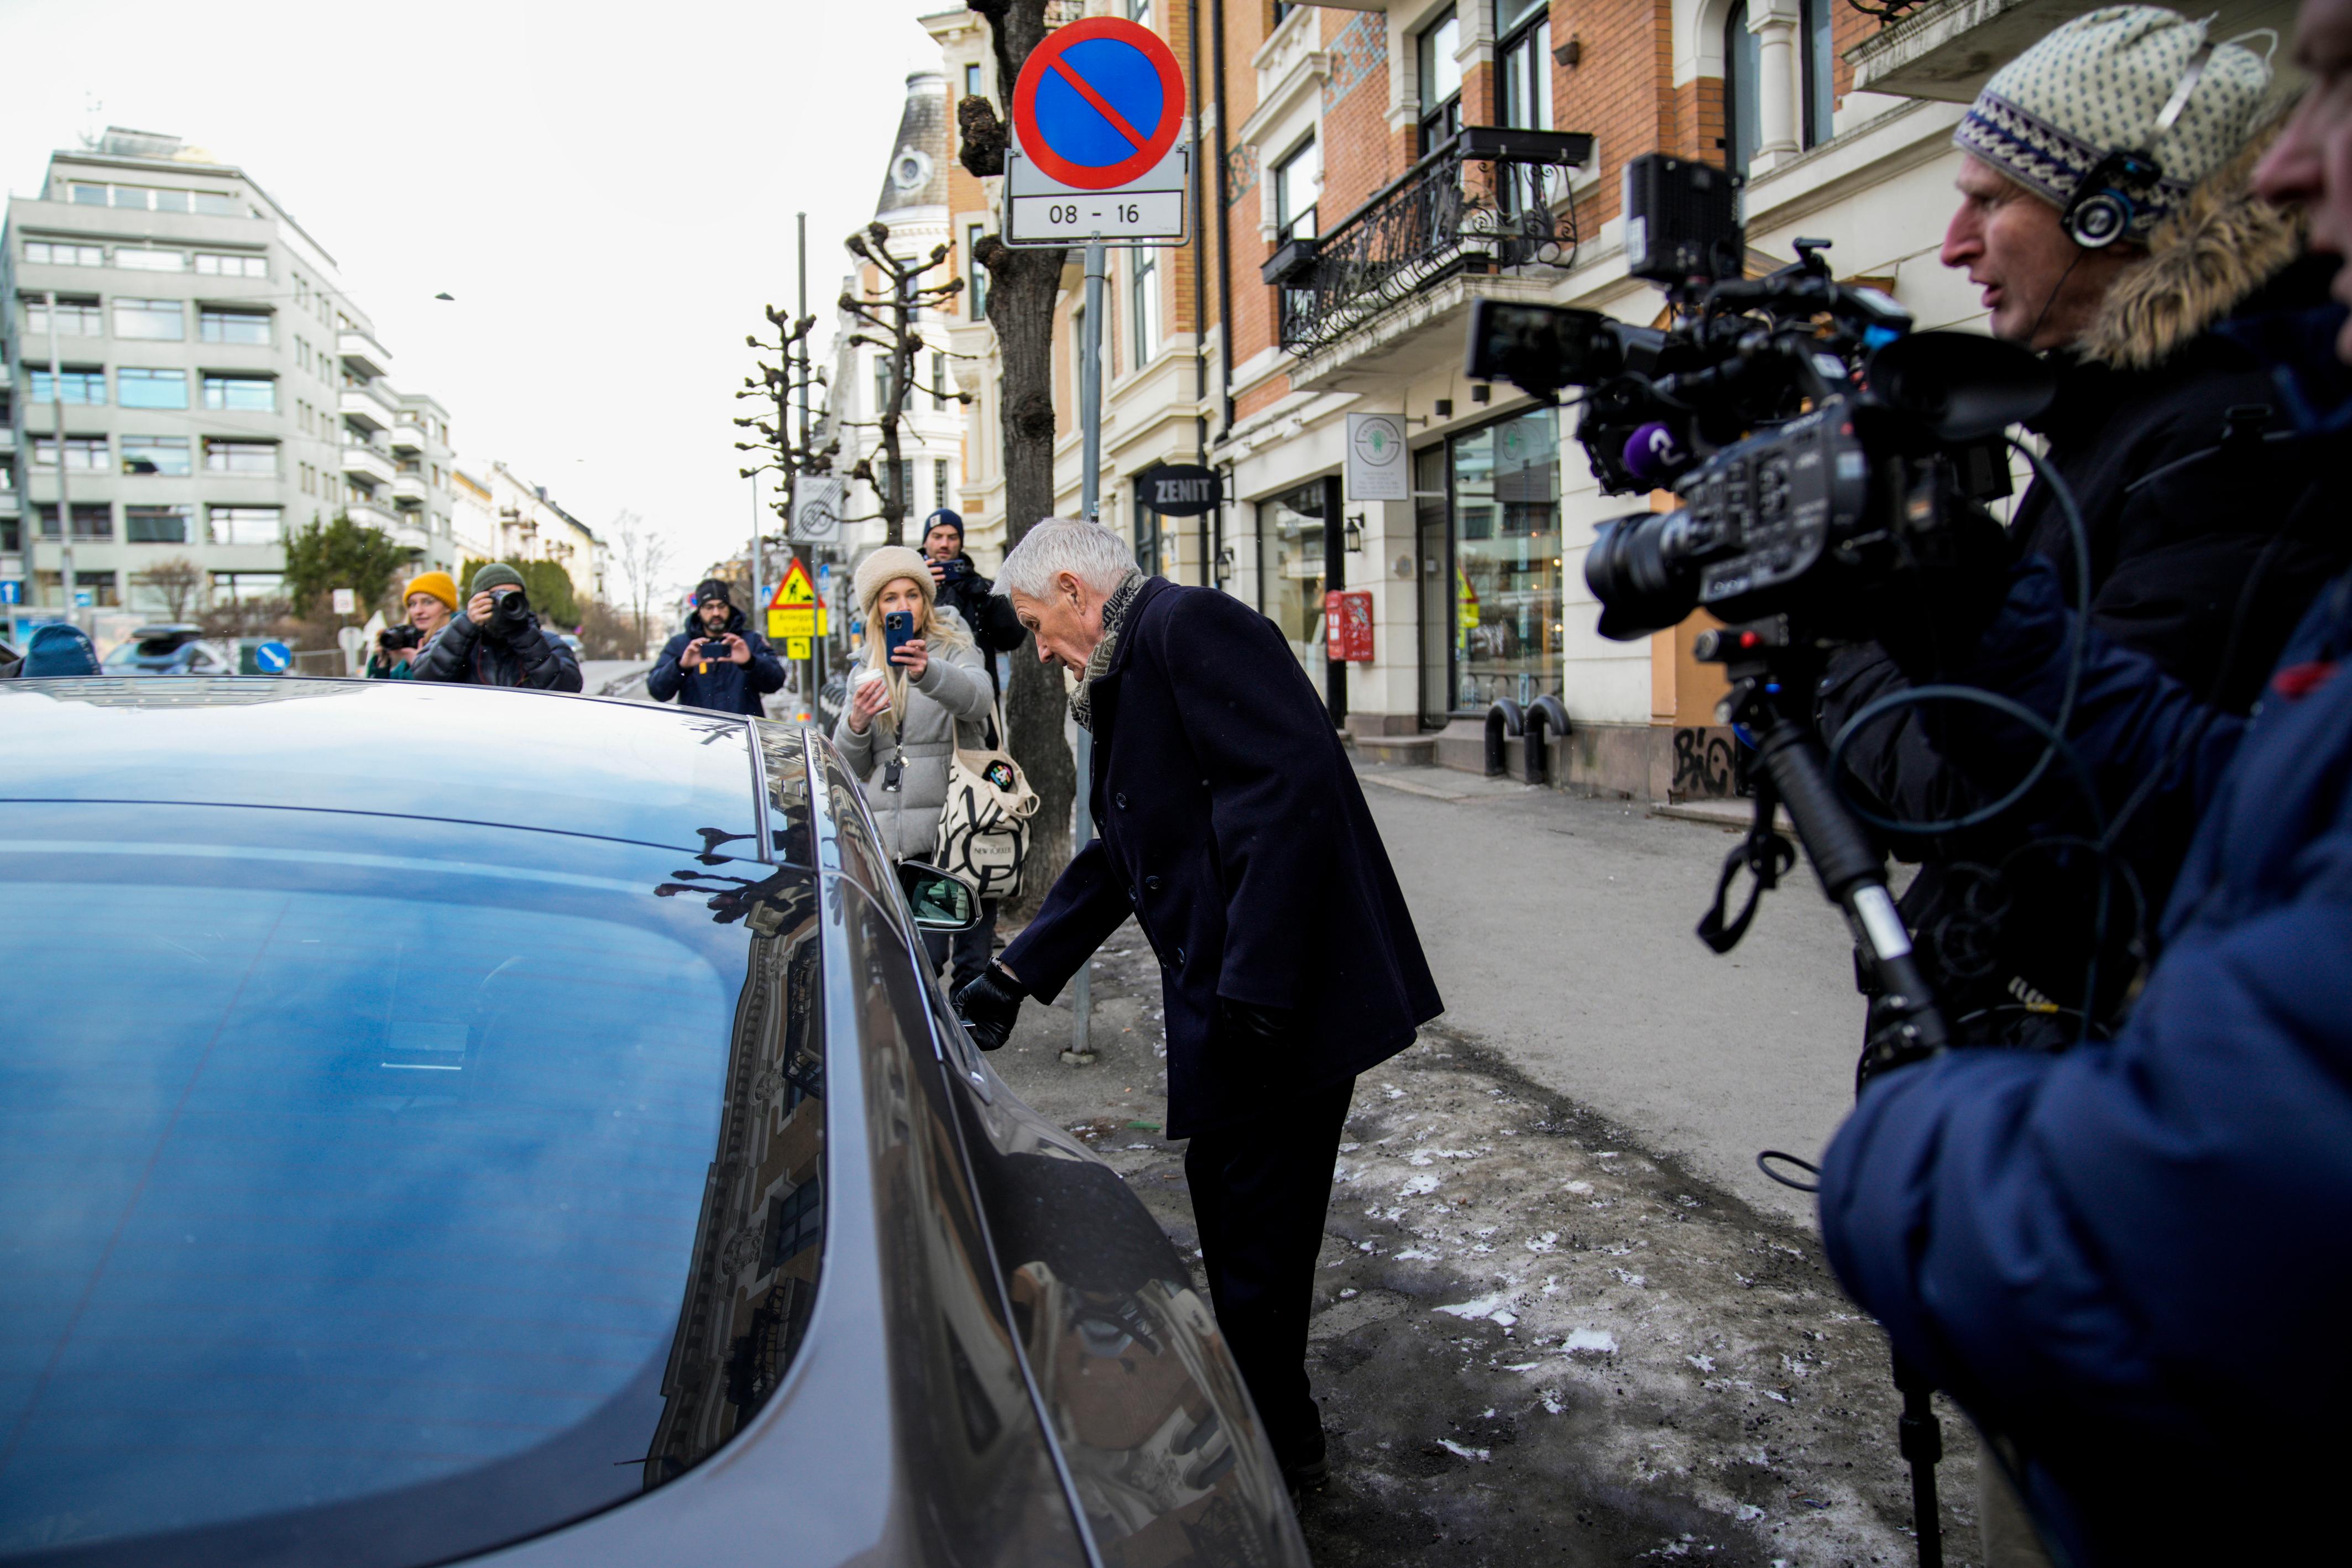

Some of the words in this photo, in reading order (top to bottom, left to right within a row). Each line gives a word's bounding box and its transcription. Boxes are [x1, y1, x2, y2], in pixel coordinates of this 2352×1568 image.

[1049, 205, 1077, 224] 08
[1118, 204, 1139, 223] 16
[1155, 479, 1210, 503] ZENIT
[996, 769, 1007, 783] 4
